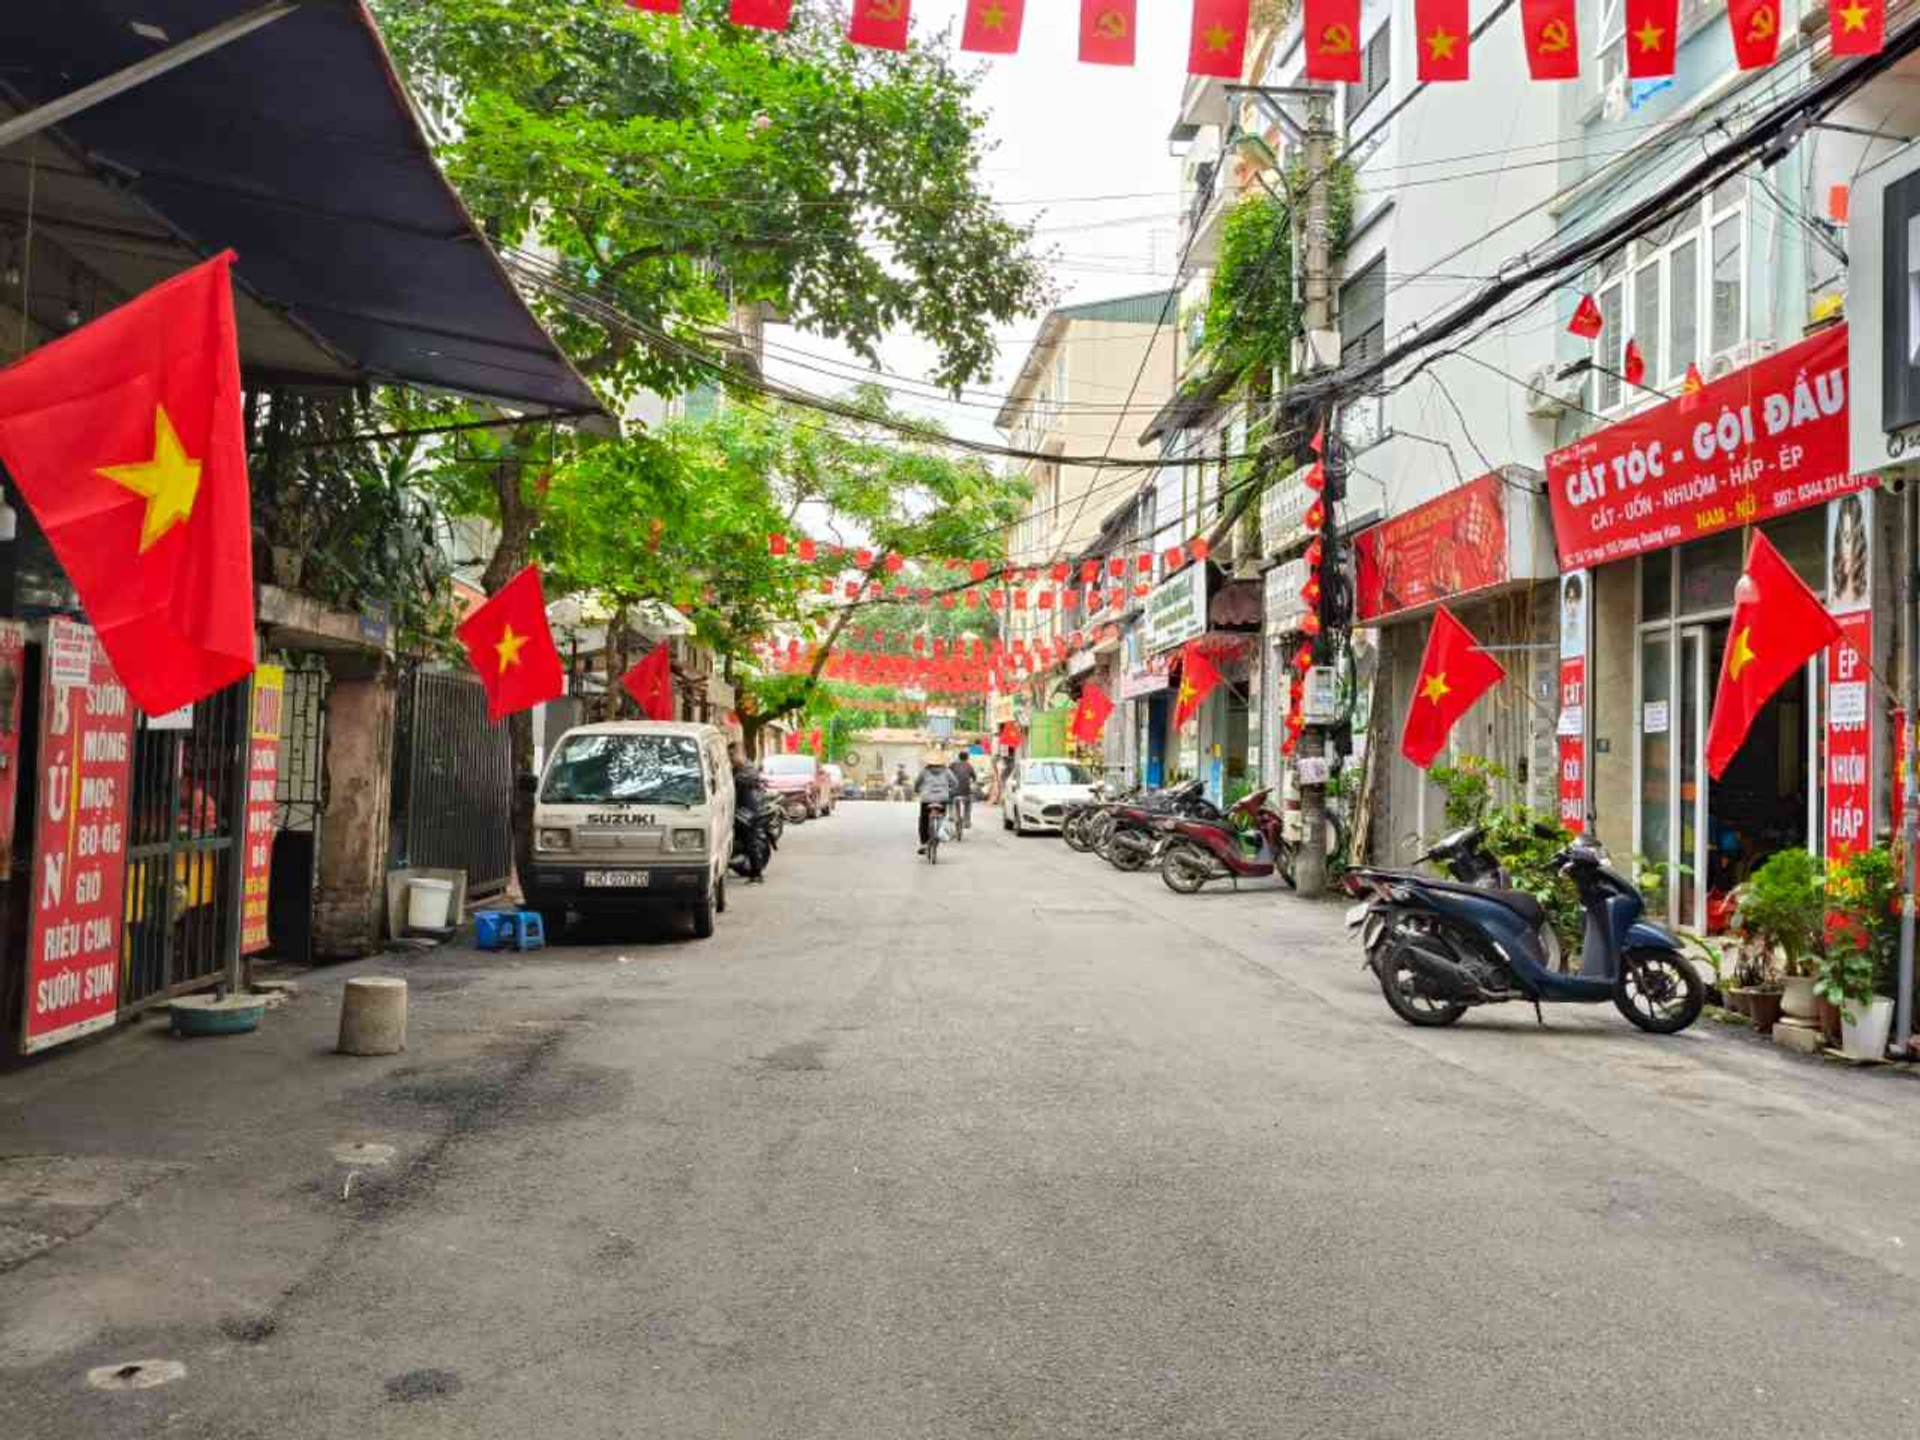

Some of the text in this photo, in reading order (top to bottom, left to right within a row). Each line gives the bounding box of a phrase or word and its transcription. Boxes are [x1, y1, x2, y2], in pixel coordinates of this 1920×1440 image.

[1566, 459, 1606, 505] CẮT
[1612, 441, 1664, 490] TÓC
[1691, 405, 1754, 461] GỘI
[1763, 367, 1846, 436] ĐẦU
[1591, 504, 1615, 530] CẮT
[1625, 490, 1653, 521] UỐN
[1663, 473, 1718, 508] NHUỘM
[1729, 456, 1764, 487] HẤP
[1778, 443, 1804, 471] ÉP
[1837, 641, 1858, 680] ÉP
[586, 814, 656, 826] SUZUKI
[1830, 797, 1863, 838] HẤP
[83, 916, 113, 951] CUA
[83, 962, 115, 1004] SỤN
